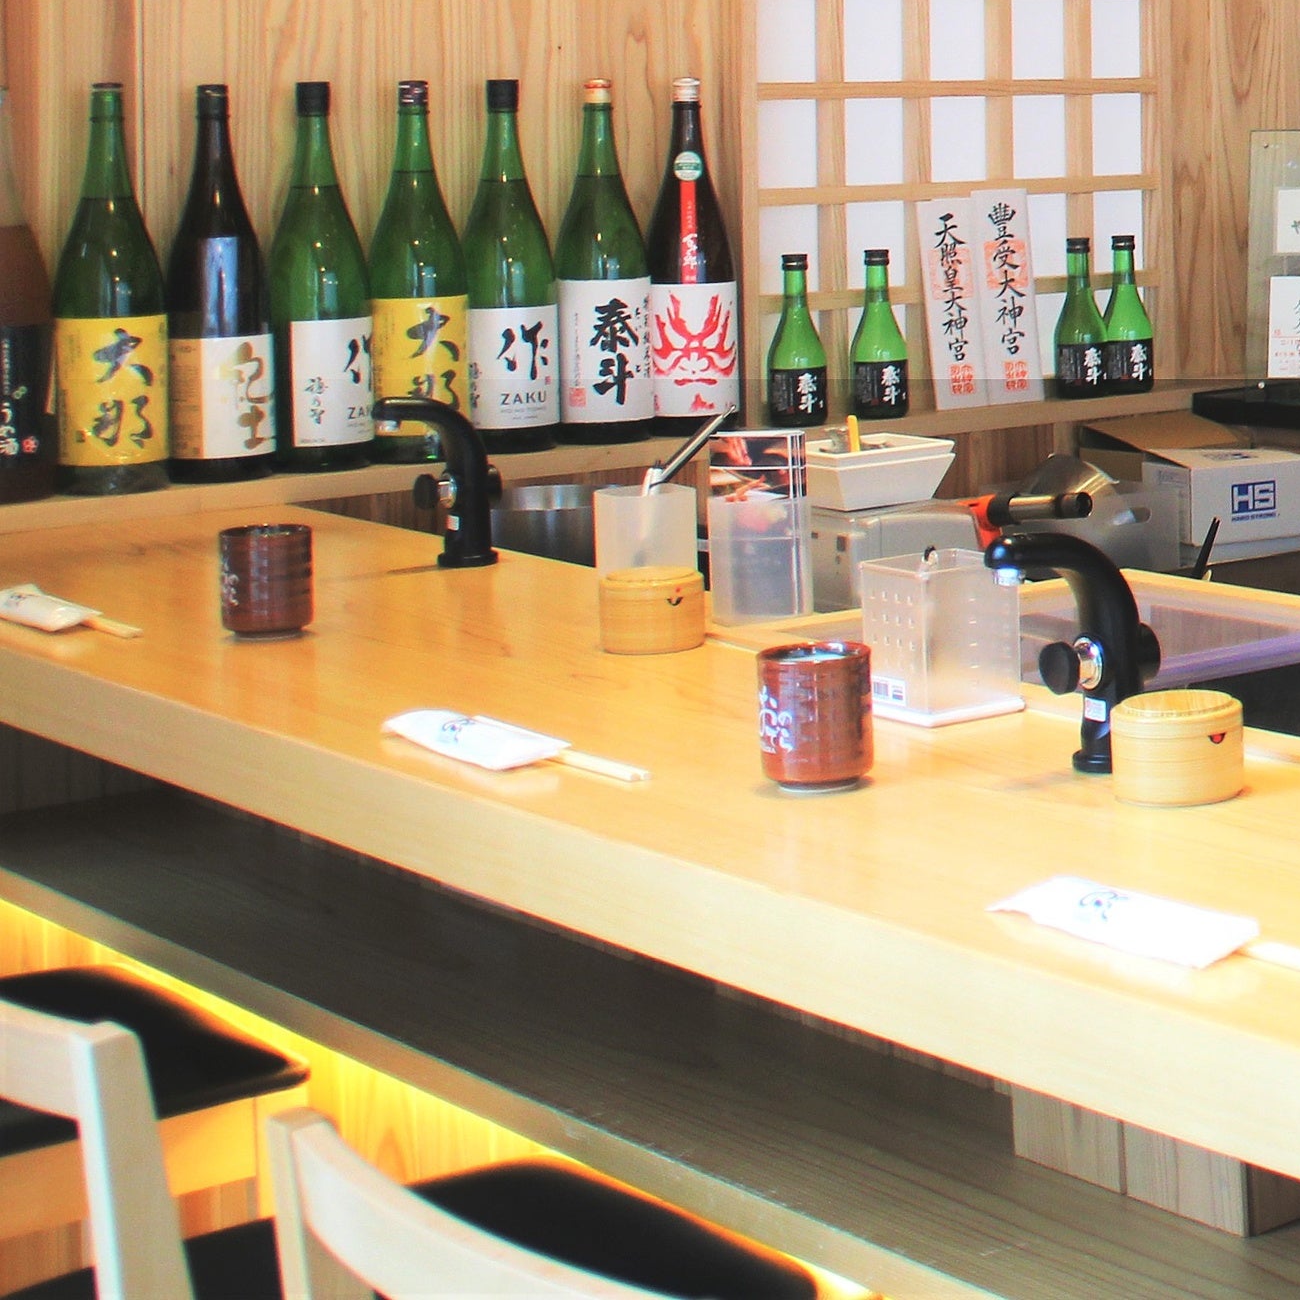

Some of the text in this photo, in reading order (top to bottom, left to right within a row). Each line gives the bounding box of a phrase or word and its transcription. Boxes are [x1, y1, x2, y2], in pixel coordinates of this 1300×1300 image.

[934, 212, 969, 362] 天照皇大神宮
[497, 320, 549, 381] 作
[590, 297, 640, 405] 泰斗
[1083, 346, 1102, 386] 泰斗
[1130, 343, 1148, 382] 泰斗
[93, 327, 154, 448] 大那
[500, 390, 547, 406] ZAKU
[796, 372, 818, 414] 泰斗
[881, 364, 901, 406] 泰斗
[1233, 482, 1275, 511] HS
